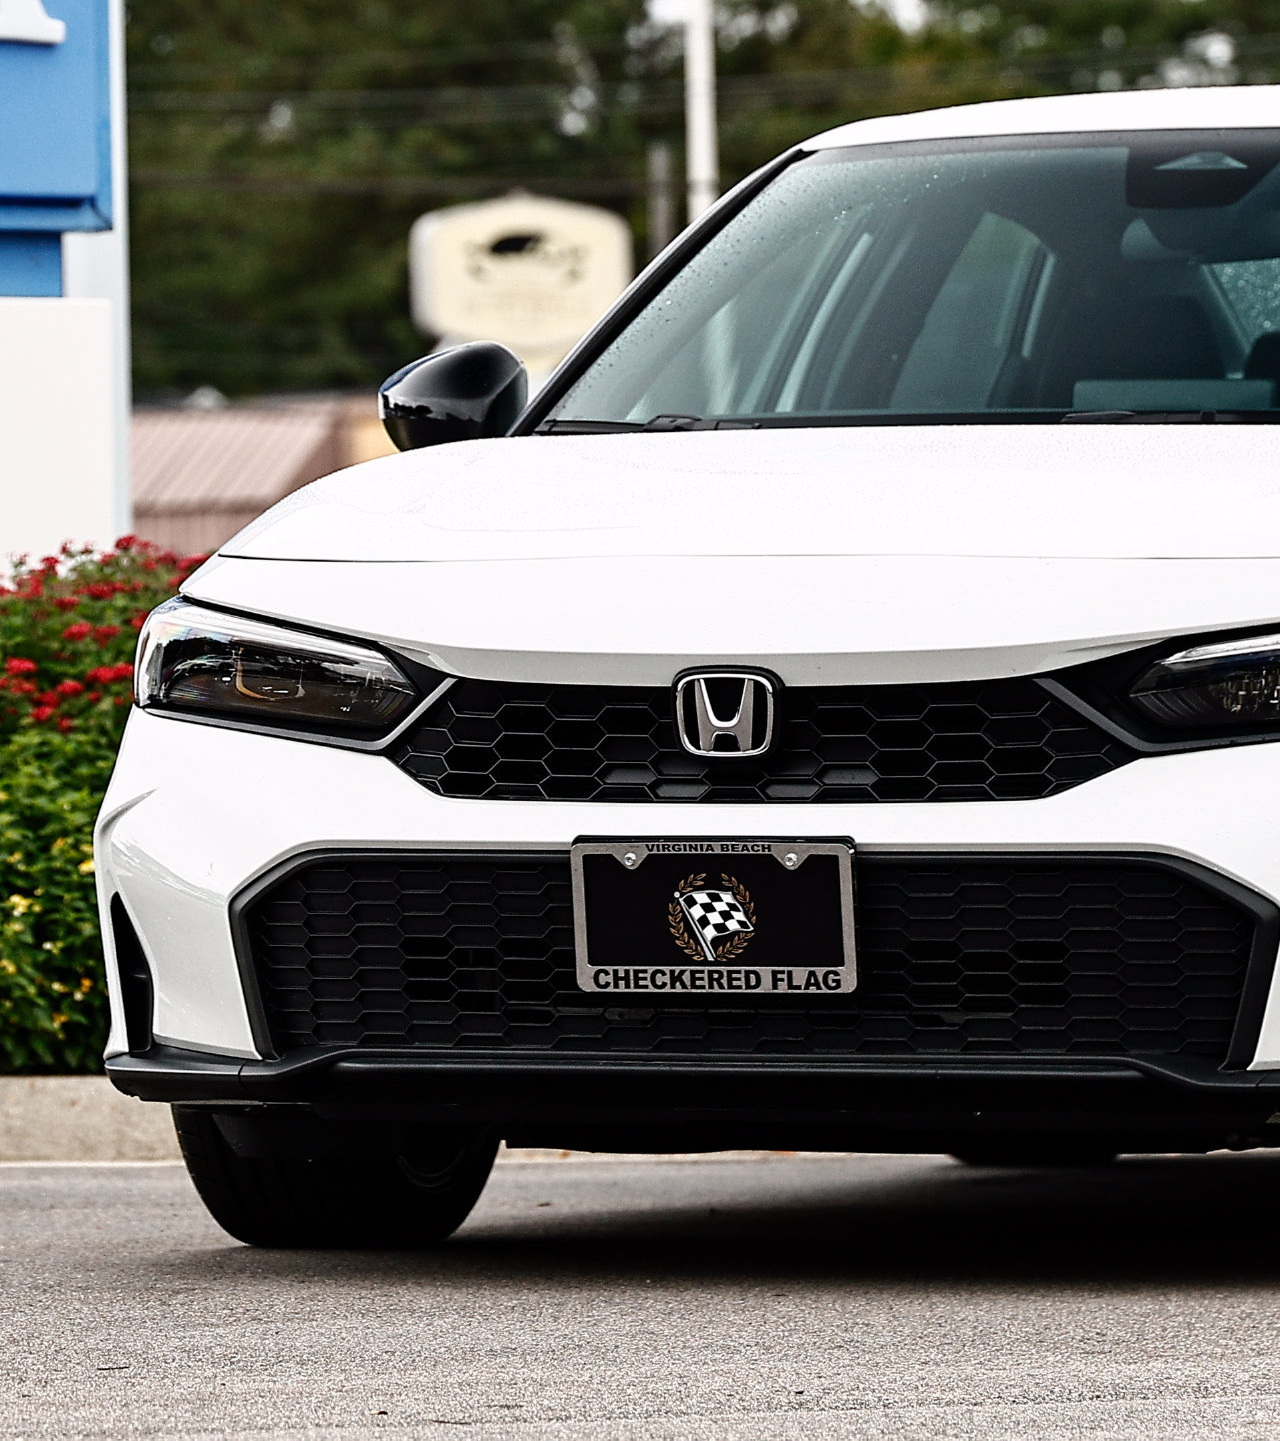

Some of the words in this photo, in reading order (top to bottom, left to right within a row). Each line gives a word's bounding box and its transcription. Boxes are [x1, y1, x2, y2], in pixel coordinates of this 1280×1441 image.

[645, 843, 715, 853] VIRGINIA
[720, 843, 772, 853] BEACH
[593, 968, 762, 990] CHECKERED
[771, 969, 842, 991] FLAG
